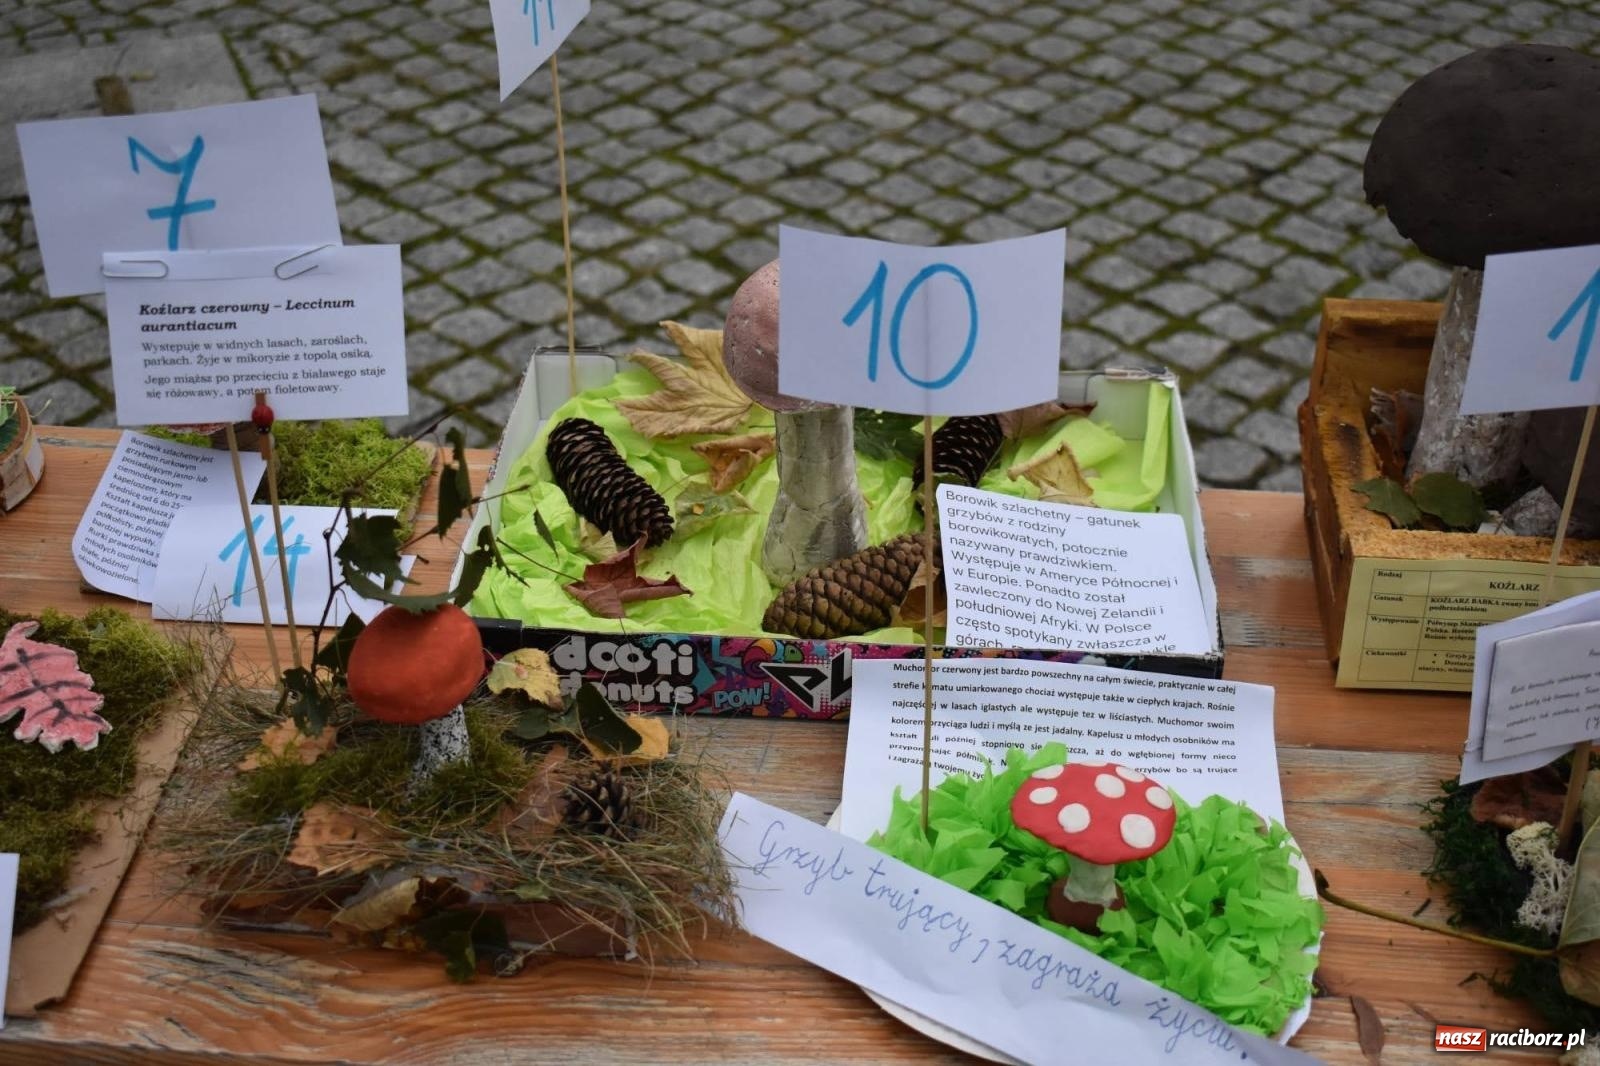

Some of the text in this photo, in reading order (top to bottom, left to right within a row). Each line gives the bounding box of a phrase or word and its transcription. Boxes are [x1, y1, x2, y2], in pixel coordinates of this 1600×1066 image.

[128, 135, 216, 250] 7
[139, 298, 355, 315] Koźlarz czerowny Leccinum
[141, 320, 237, 332] aurantiacum
[842, 260, 978, 390] 10
[142, 341, 200, 354] Występuje
[217, 338, 263, 351] widnych
[267, 336, 304, 347] lasach,
[311, 334, 367, 345] zaroślach,
[143, 355, 191, 368] parkach.
[197, 354, 219, 366] Żyje
[236, 351, 291, 364] mikoryzie
[303, 349, 337, 362] topolą
[341, 348, 372, 360] osiką.
[145, 374, 170, 386] Jego
[175, 372, 212, 385] miąższ
[216, 374, 229, 384] po
[233, 370, 289, 383] przecięciu
[303, 369, 356, 380] białawego
[361, 366, 385, 378] staje
[147, 388, 160, 400] się
[165, 387, 222, 398] różowawy,
[275, 383, 341, 394] fioletowawy.
[946, 490, 1141, 528] Borowik szlachetny gatunek
[948, 508, 1002, 523] grzybów
[1019, 518, 1065, 538] rodziny
[949, 518, 1128, 557] borowikowatych, potocznie
[219, 515, 311, 607] 14
[950, 537, 1116, 571] nazywany prawdziwkiem.
[952, 549, 1020, 573] Występuje
[1040, 565, 1097, 586] Ameryce
[1103, 576, 1170, 590] Północnej
[968, 567, 1021, 588] Europie.
[1026, 577, 1079, 599] Ponadto
[1085, 592, 1125, 603] został
[1489, 581, 1540, 592] KOŹLARZ
[954, 583, 1030, 607] zawleczony
[1036, 596, 1052, 609] do
[1056, 600, 1097, 620] Nowej
[1101, 605, 1156, 618] Zelandii
[956, 600, 1152, 633] południowej Afryki. W Polsce
[956, 617, 1000, 631] często
[1005, 626, 1072, 651] spotykany
[1077, 636, 1150, 648] zwłaszcza
[1155, 634, 1166, 642] w
[894, 663, 939, 672] Muchoor
[942, 667, 981, 676] czerwony
[984, 667, 998, 676] jest
[1001, 667, 1029, 675] bardzo
[1031, 671, 1081, 683] powszechny
[1097, 676, 1120, 685] całym
[1123, 677, 1155, 687] świecie,
[1158, 681, 1205, 691] praktycznie
[1217, 685, 1235, 694] całej
[713, 682, 772, 708] POW!
[893, 681, 919, 689] strefie
[956, 684, 1022, 694] umiarkowanego
[1025, 687, 1054, 696] chociaż
[1058, 691, 1100, 701] występuje
[1103, 693, 1124, 702] także
[1137, 696, 1170, 707] ciepłych
[1173, 699, 1204, 709] krajach.
[1208, 702, 1234, 711] Rośnie
[952, 702, 977, 710] lasach
[981, 703, 1016, 713] iglastych
[1037, 707, 1078, 718] występuje
[1083, 710, 1094, 718] tez
[1110, 712, 1153, 723] liściastych.
[1158, 716, 1203, 726] Muchomor
[1207, 721, 1234, 729] swoim
[891, 731, 917, 739] kształt
[946, 735, 975, 745] później
[1128, 750, 1175, 760] wgłębionej
[1182, 752, 1206, 761] formy
[970, 721, 990, 729] ludzi
[998, 723, 1020, 732] myślą
[1035, 724, 1049, 733] jest
[1052, 726, 1084, 737] jadalny.
[1088, 729, 1123, 739] Kapelusz
[1135, 733, 1170, 743] młodych
[1173, 736, 1219, 744] osobników
[1208, 765, 1237, 774] trujące
[754, 820, 853, 896] Grzyb
[997, 939, 1121, 1007] zagraża
[1145, 997, 1249, 1060] życiu.
